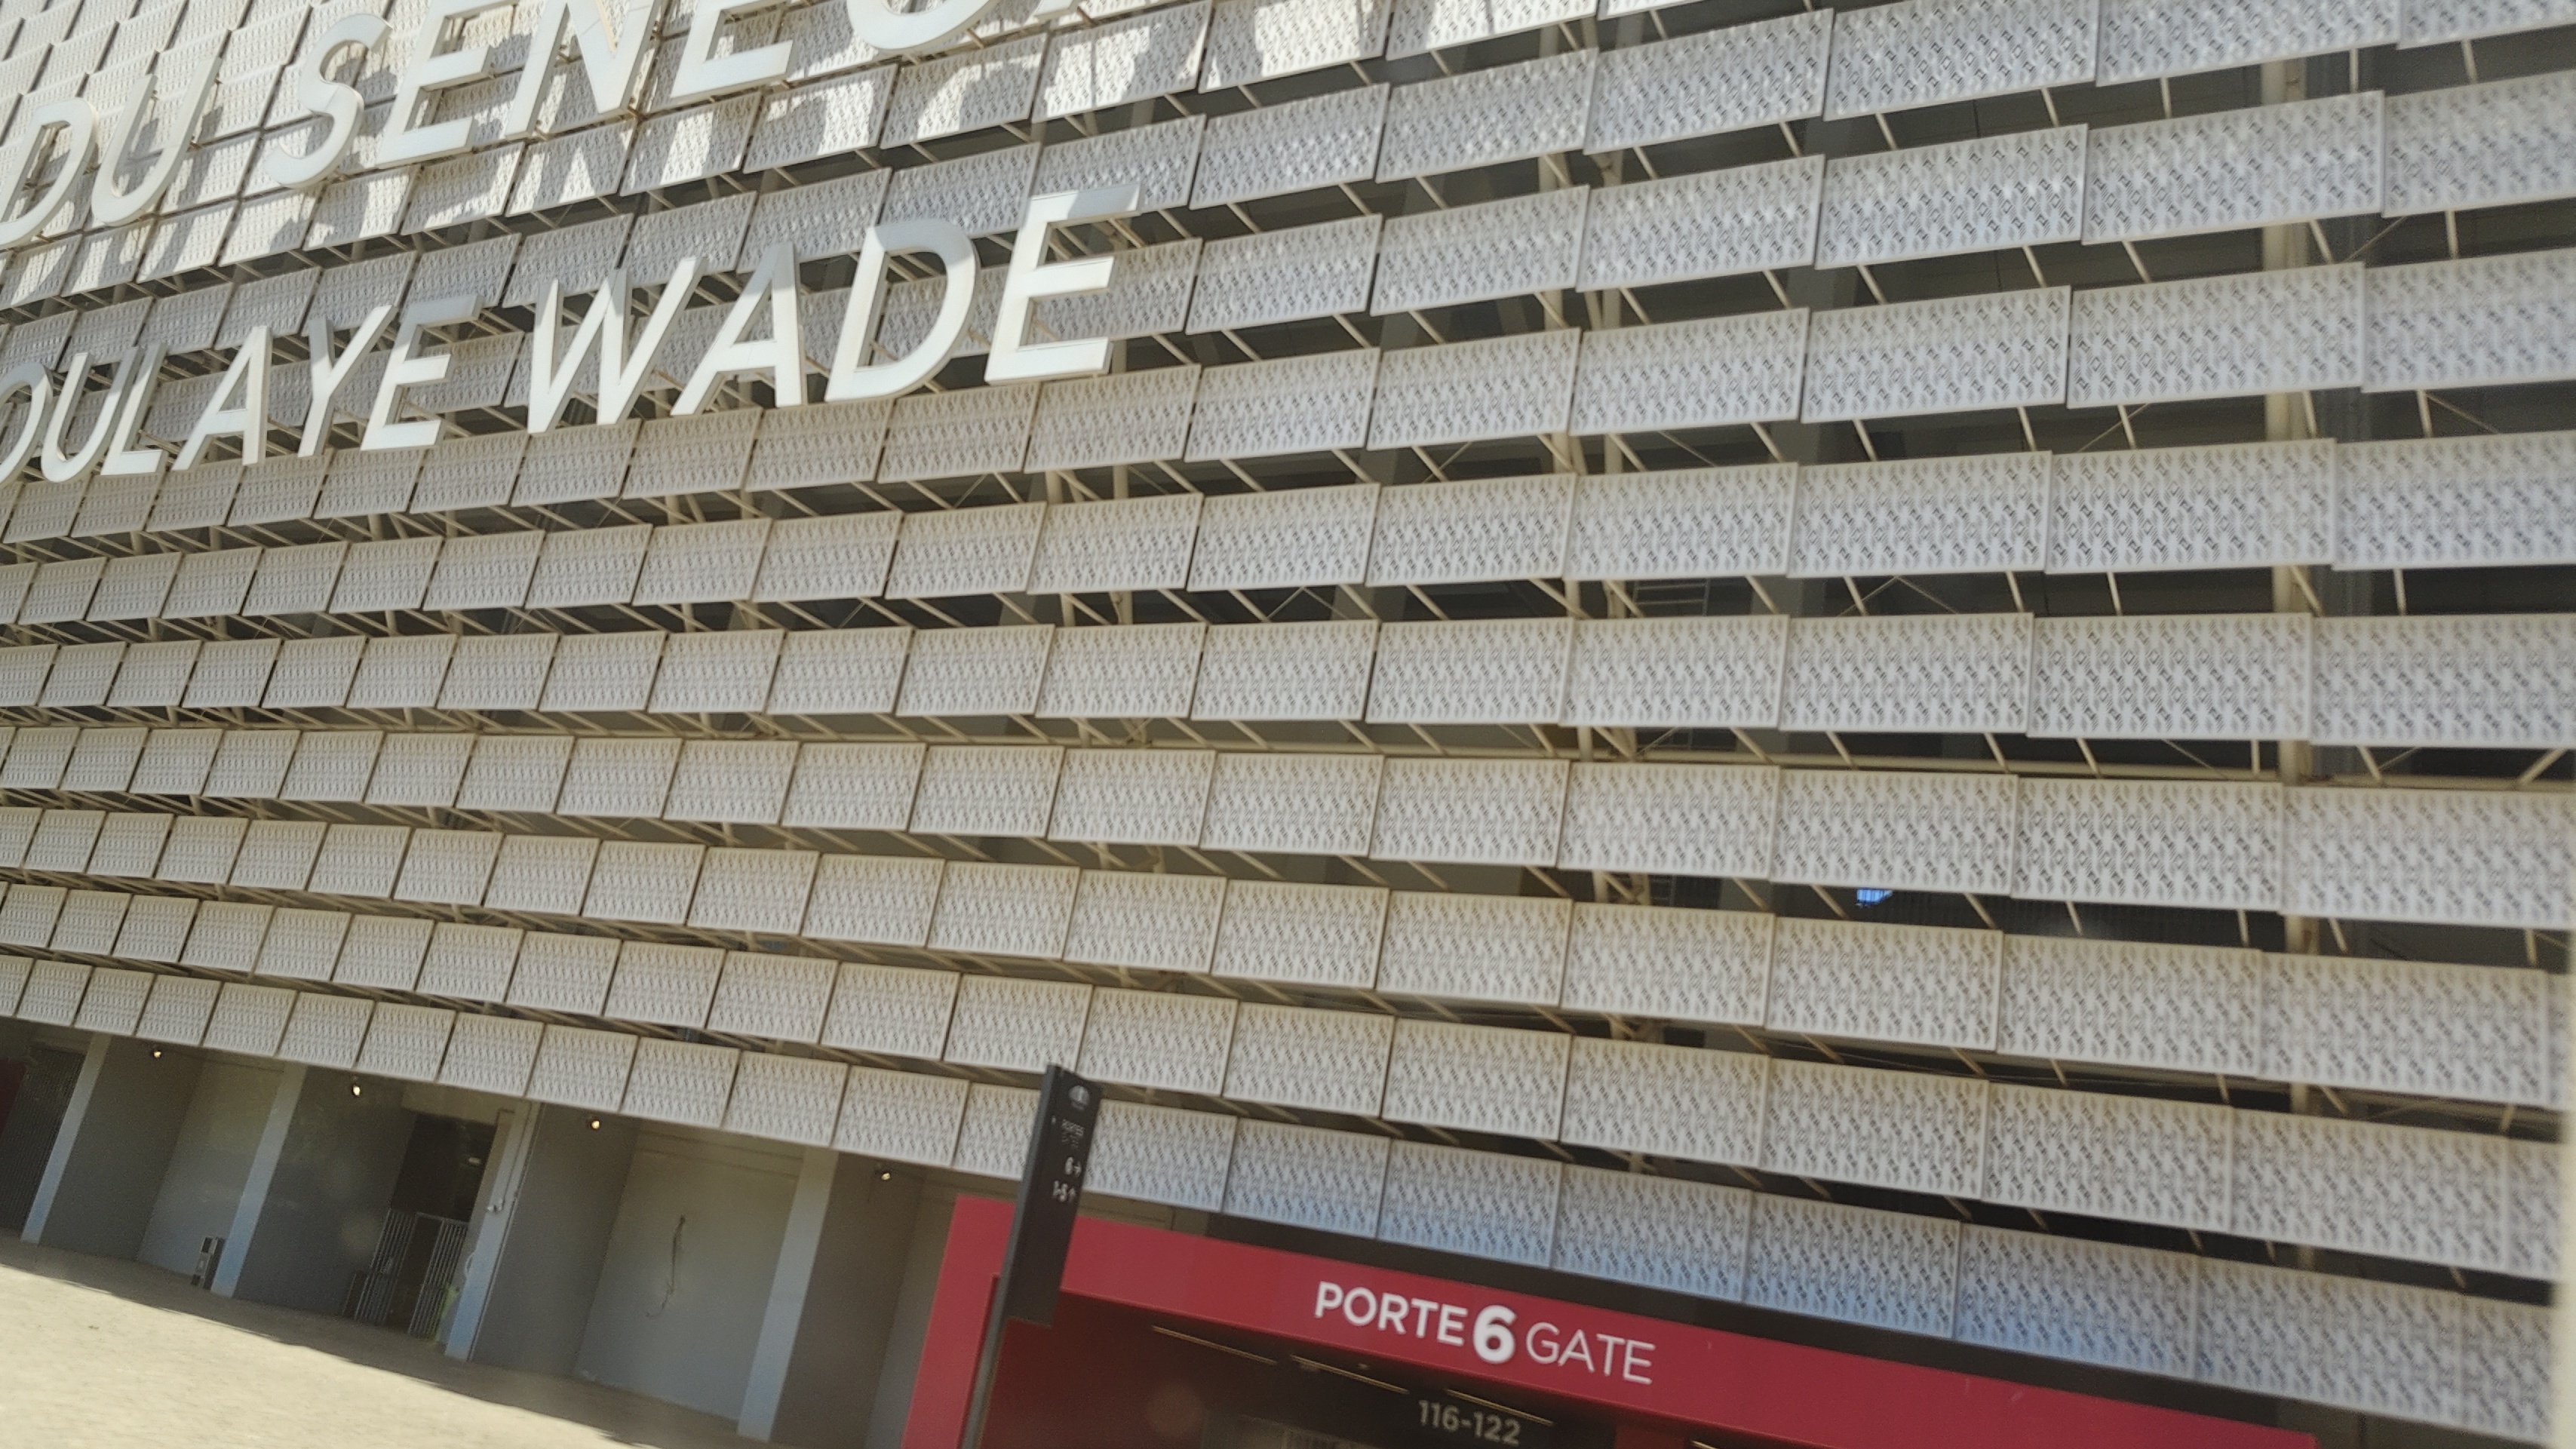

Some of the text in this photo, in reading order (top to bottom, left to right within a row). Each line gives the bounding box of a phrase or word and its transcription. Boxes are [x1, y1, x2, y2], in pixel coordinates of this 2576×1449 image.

[0, 56, 222, 250] DU
[527, 183, 1141, 435] WADE
[1314, 1281, 1656, 1385] PORTE 6 GATE
[1418, 1399, 1521, 1445] 116-122
